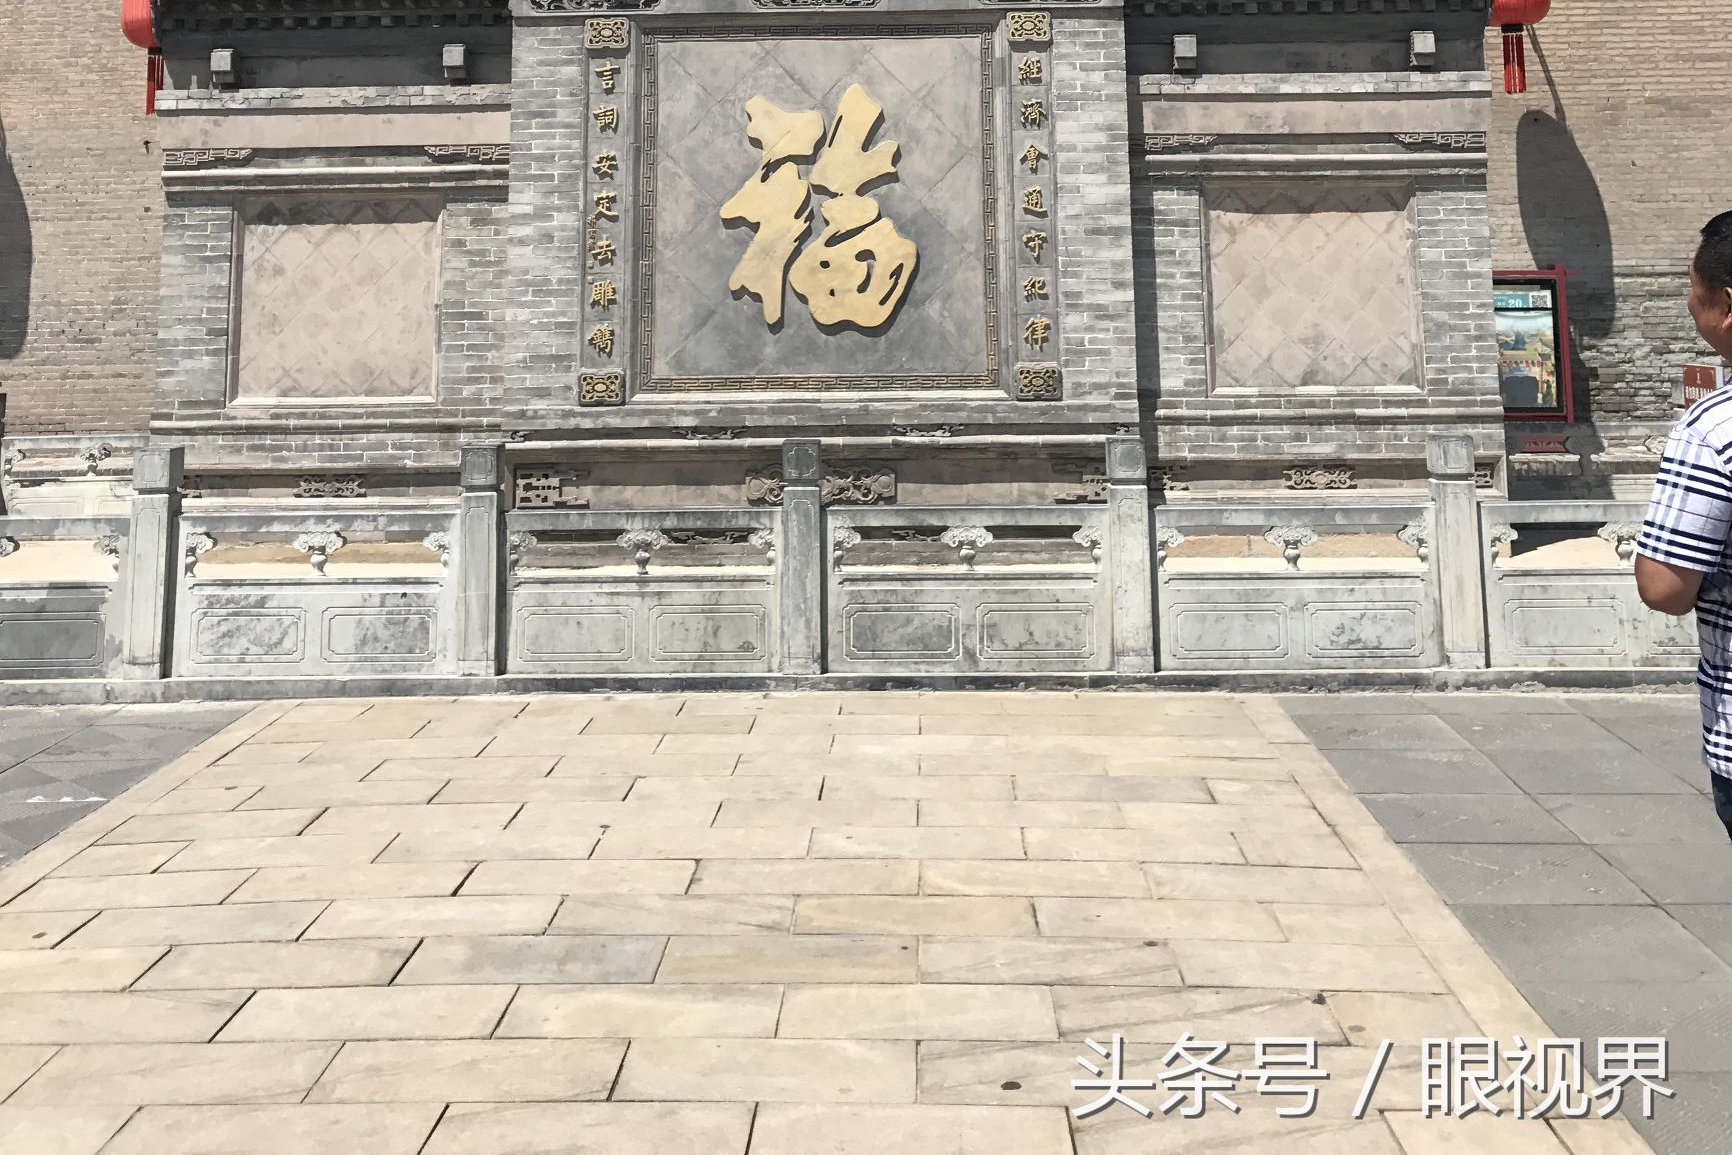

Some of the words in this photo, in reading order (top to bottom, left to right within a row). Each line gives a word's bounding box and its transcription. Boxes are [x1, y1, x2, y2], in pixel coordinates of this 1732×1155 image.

[719, 83, 918, 328] 福
[1018, 55, 1047, 352] 經濟會通守紀律
